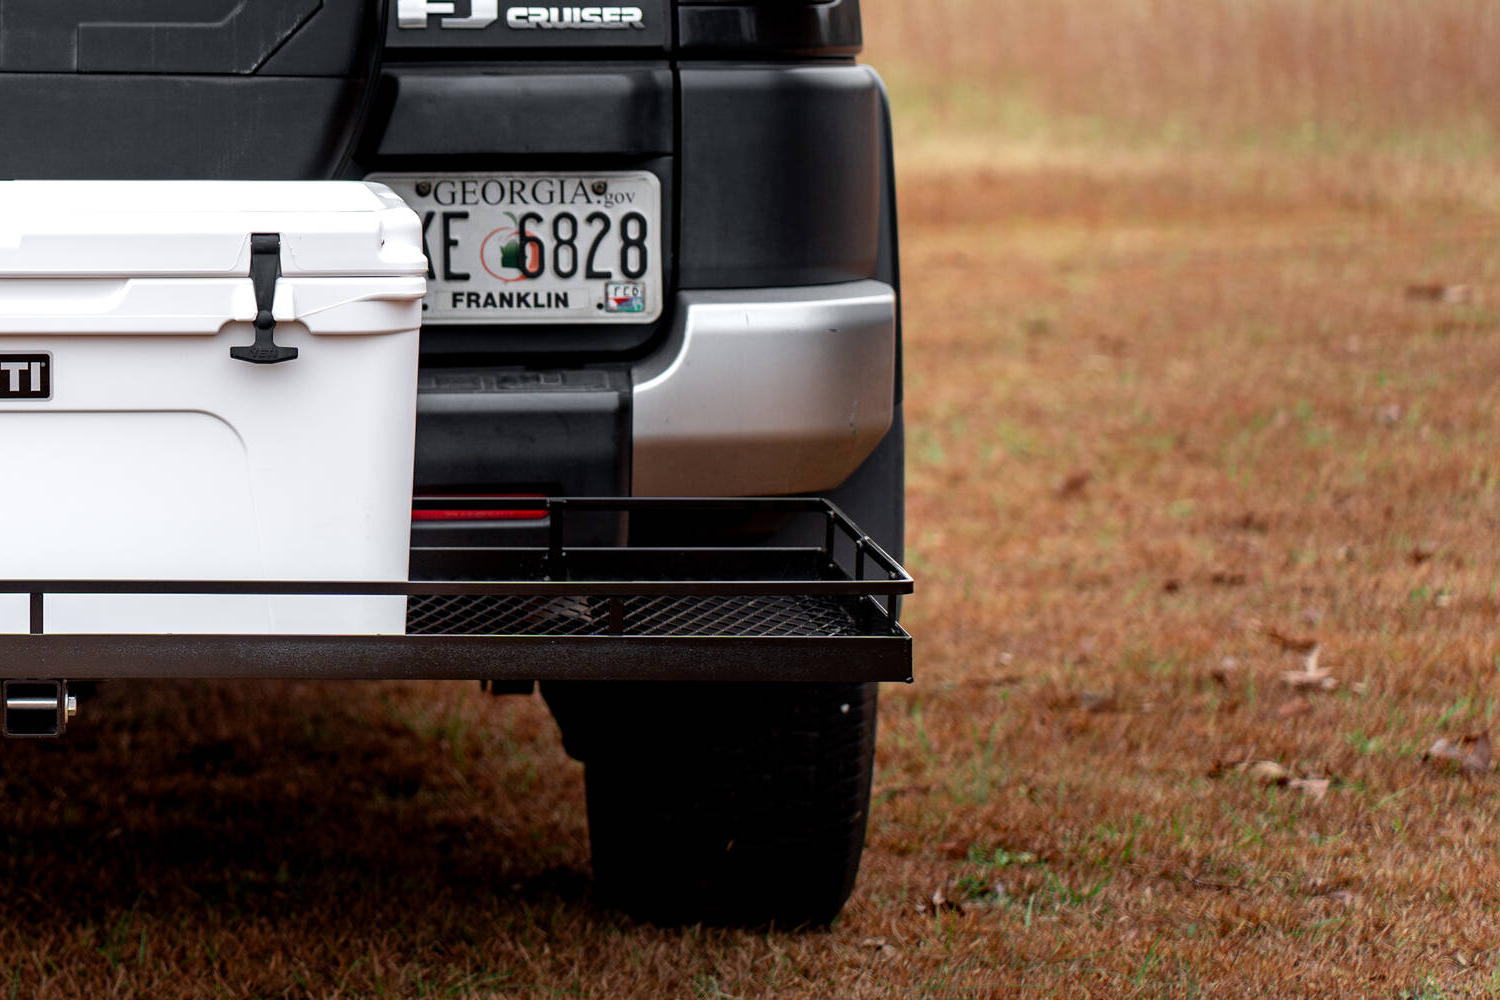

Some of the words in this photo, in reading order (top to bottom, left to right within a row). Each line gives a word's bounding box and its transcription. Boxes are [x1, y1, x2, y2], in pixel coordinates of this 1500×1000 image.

[506, 6, 646, 30] CRUISER
[518, 210, 649, 280] 6828
[451, 291, 570, 309] FRANKLIN
